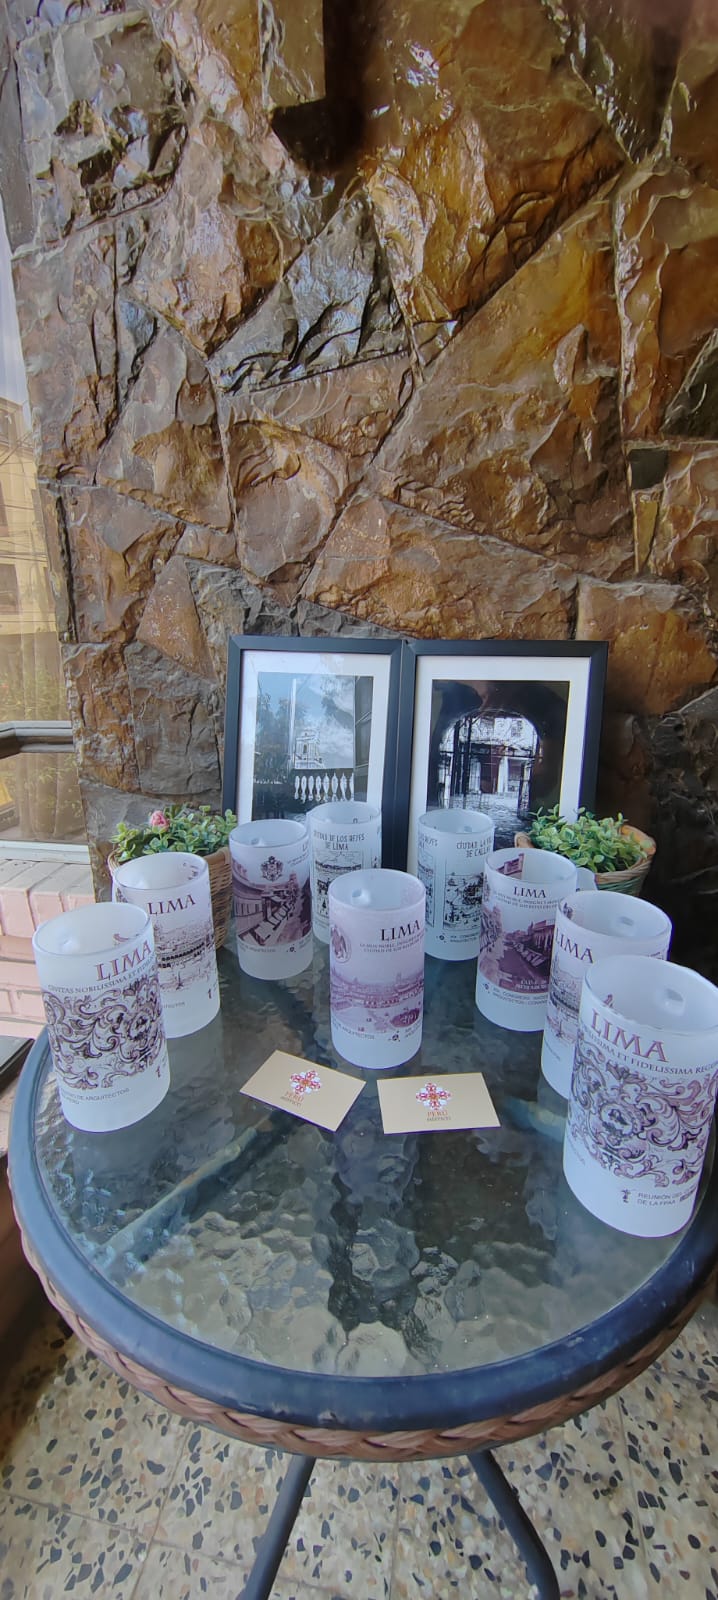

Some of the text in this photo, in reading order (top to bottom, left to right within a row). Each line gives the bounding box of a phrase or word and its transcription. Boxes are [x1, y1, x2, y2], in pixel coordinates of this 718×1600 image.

[332, 842, 349, 851] LIMA
[513, 886, 547, 899] LIMA
[147, 894, 197, 917] LIMA
[381, 919, 421, 942] LIMA
[555, 928, 594, 965] LIMA
[94, 940, 152, 981] LIMA
[592, 1008, 669, 1063] LIMA
[631, 1058, 693, 1075] FIDELISSIMA
